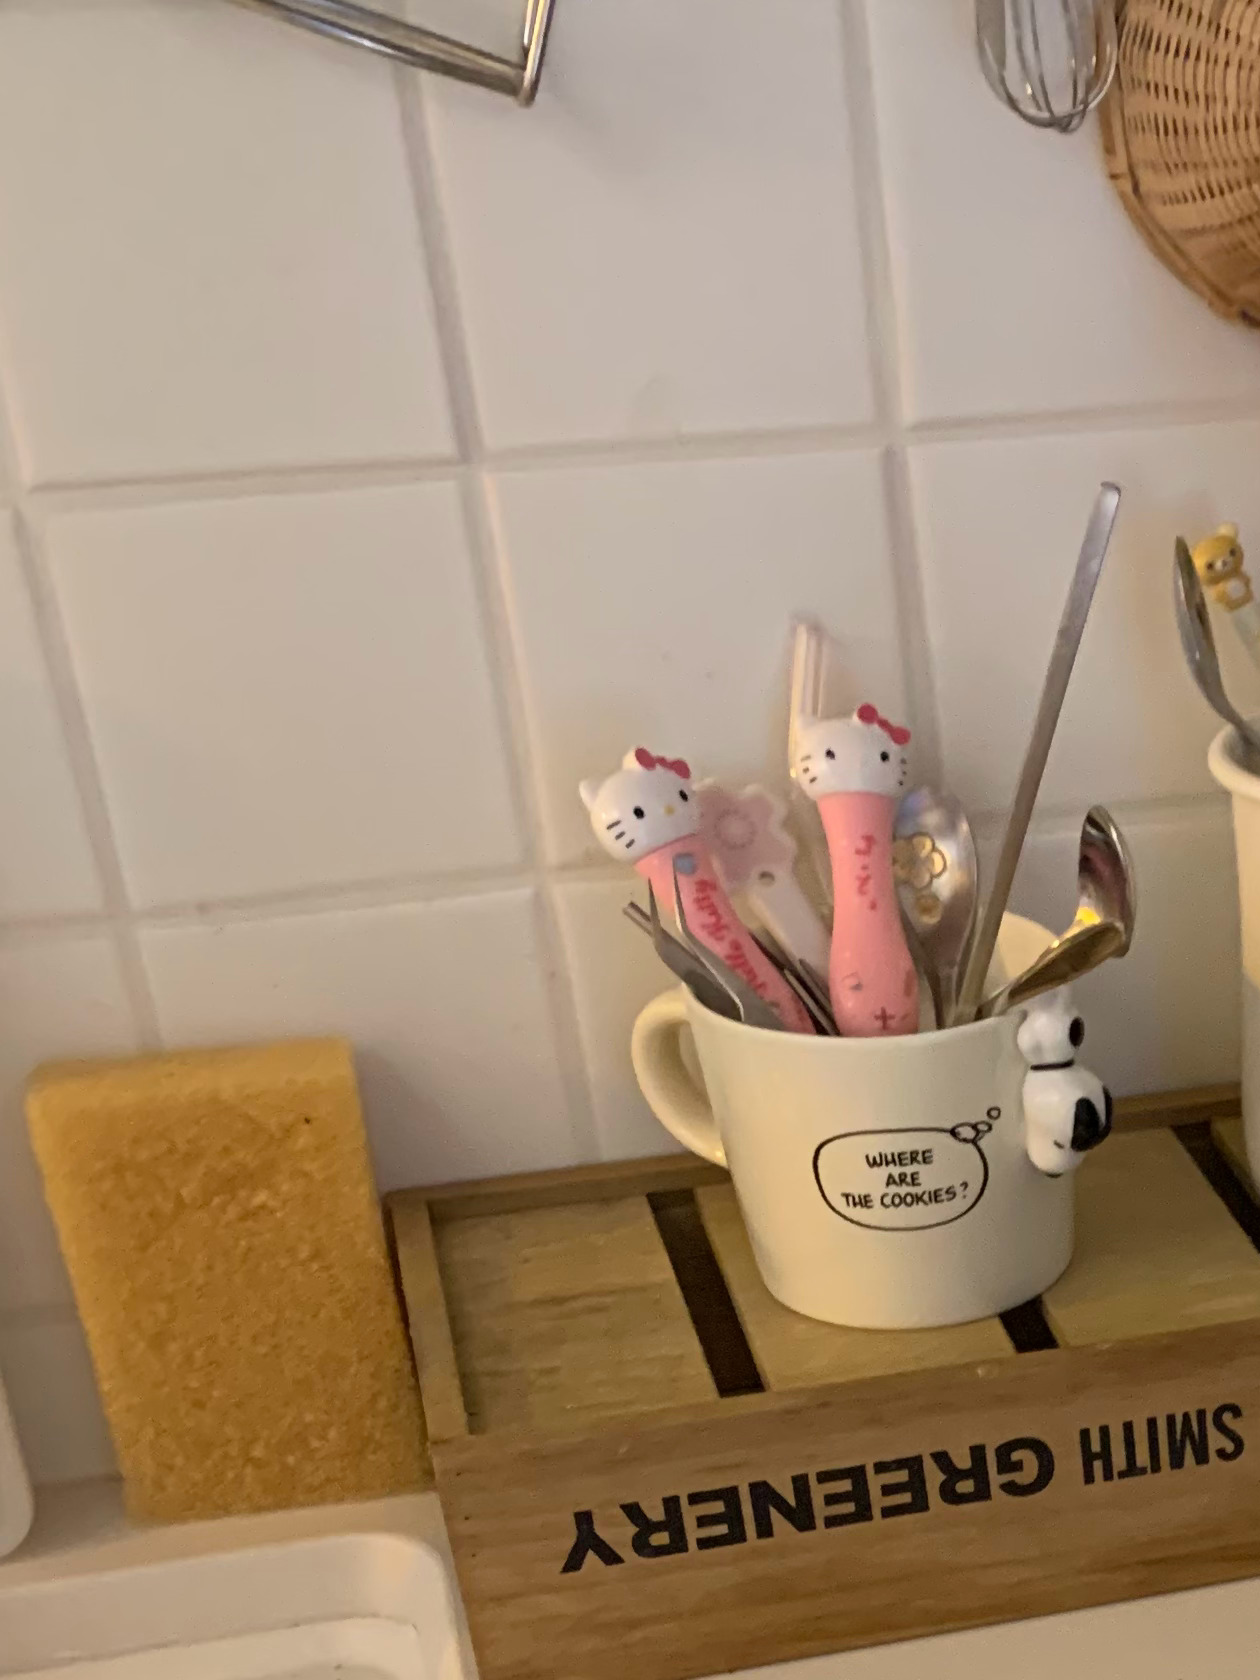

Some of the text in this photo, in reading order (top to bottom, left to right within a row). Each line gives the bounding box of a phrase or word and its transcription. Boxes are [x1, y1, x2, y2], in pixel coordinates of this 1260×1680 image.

[864, 1148, 934, 1169] WHERE
[885, 1171, 921, 1189] ARE
[841, 1191, 874, 1209] THE
[1080, 1403, 1245, 1485] SMITH
[560, 1437, 1055, 1574] GREENERY
